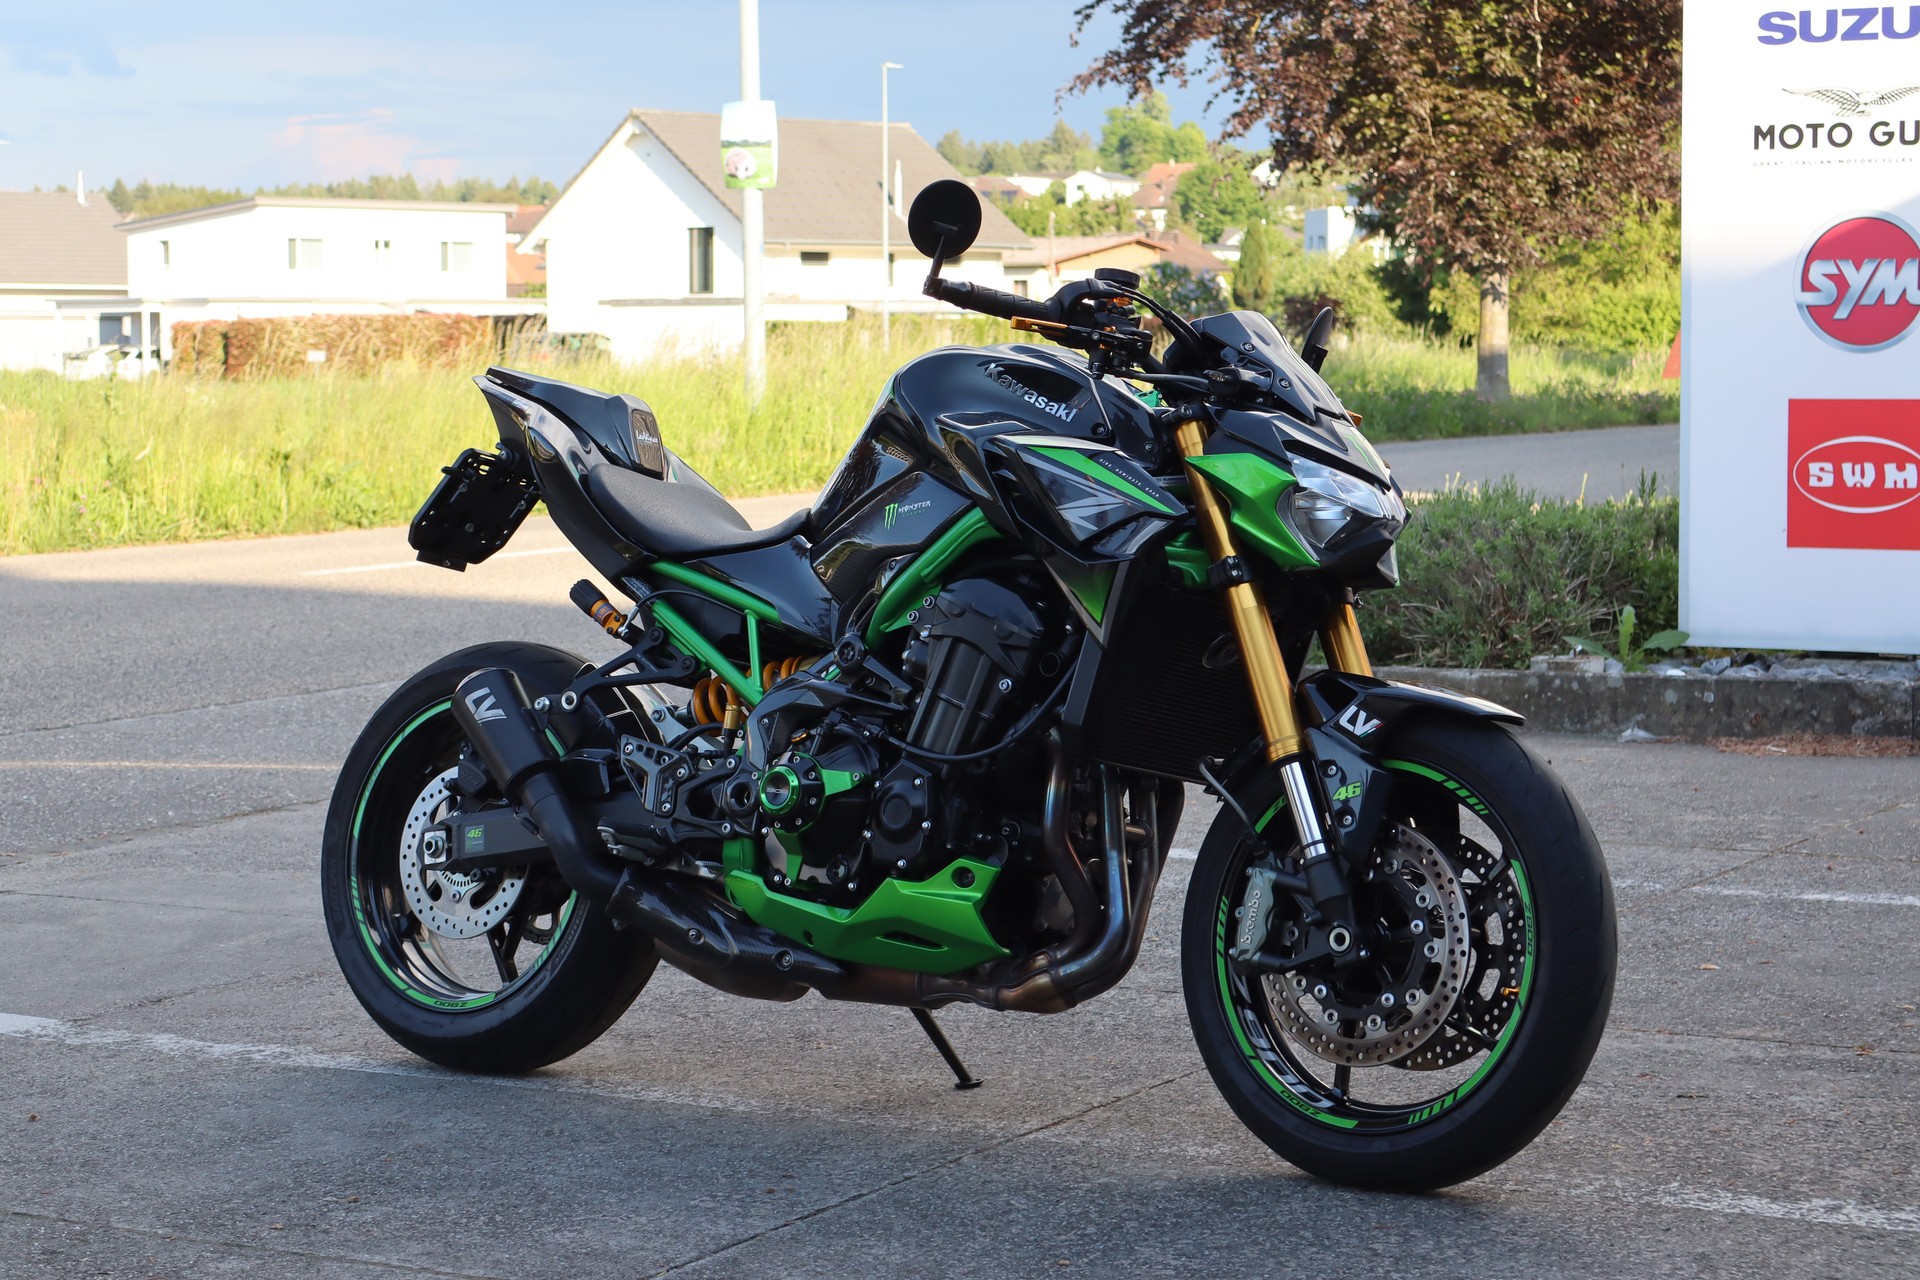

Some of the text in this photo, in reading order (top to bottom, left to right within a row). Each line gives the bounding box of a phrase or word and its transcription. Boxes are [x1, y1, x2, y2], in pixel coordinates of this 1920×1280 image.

[1757, 5, 1920, 46] SUZU
[1753, 119, 1920, 150] MOTO GU
[1800, 258, 1920, 320] SYM
[984, 362, 1079, 423] Kawasaki
[1808, 462, 1918, 489] SWM
[898, 500, 931, 513] MONSTER
[1339, 705, 1381, 737] LV
[1333, 782, 1361, 800] 46
[467, 828, 483, 838] 46
[1241, 890, 1261, 944] brembo
[1523, 902, 1534, 956] Z900
[434, 1000, 468, 1008] Z900
[1279, 1089, 1322, 1117] Z900
